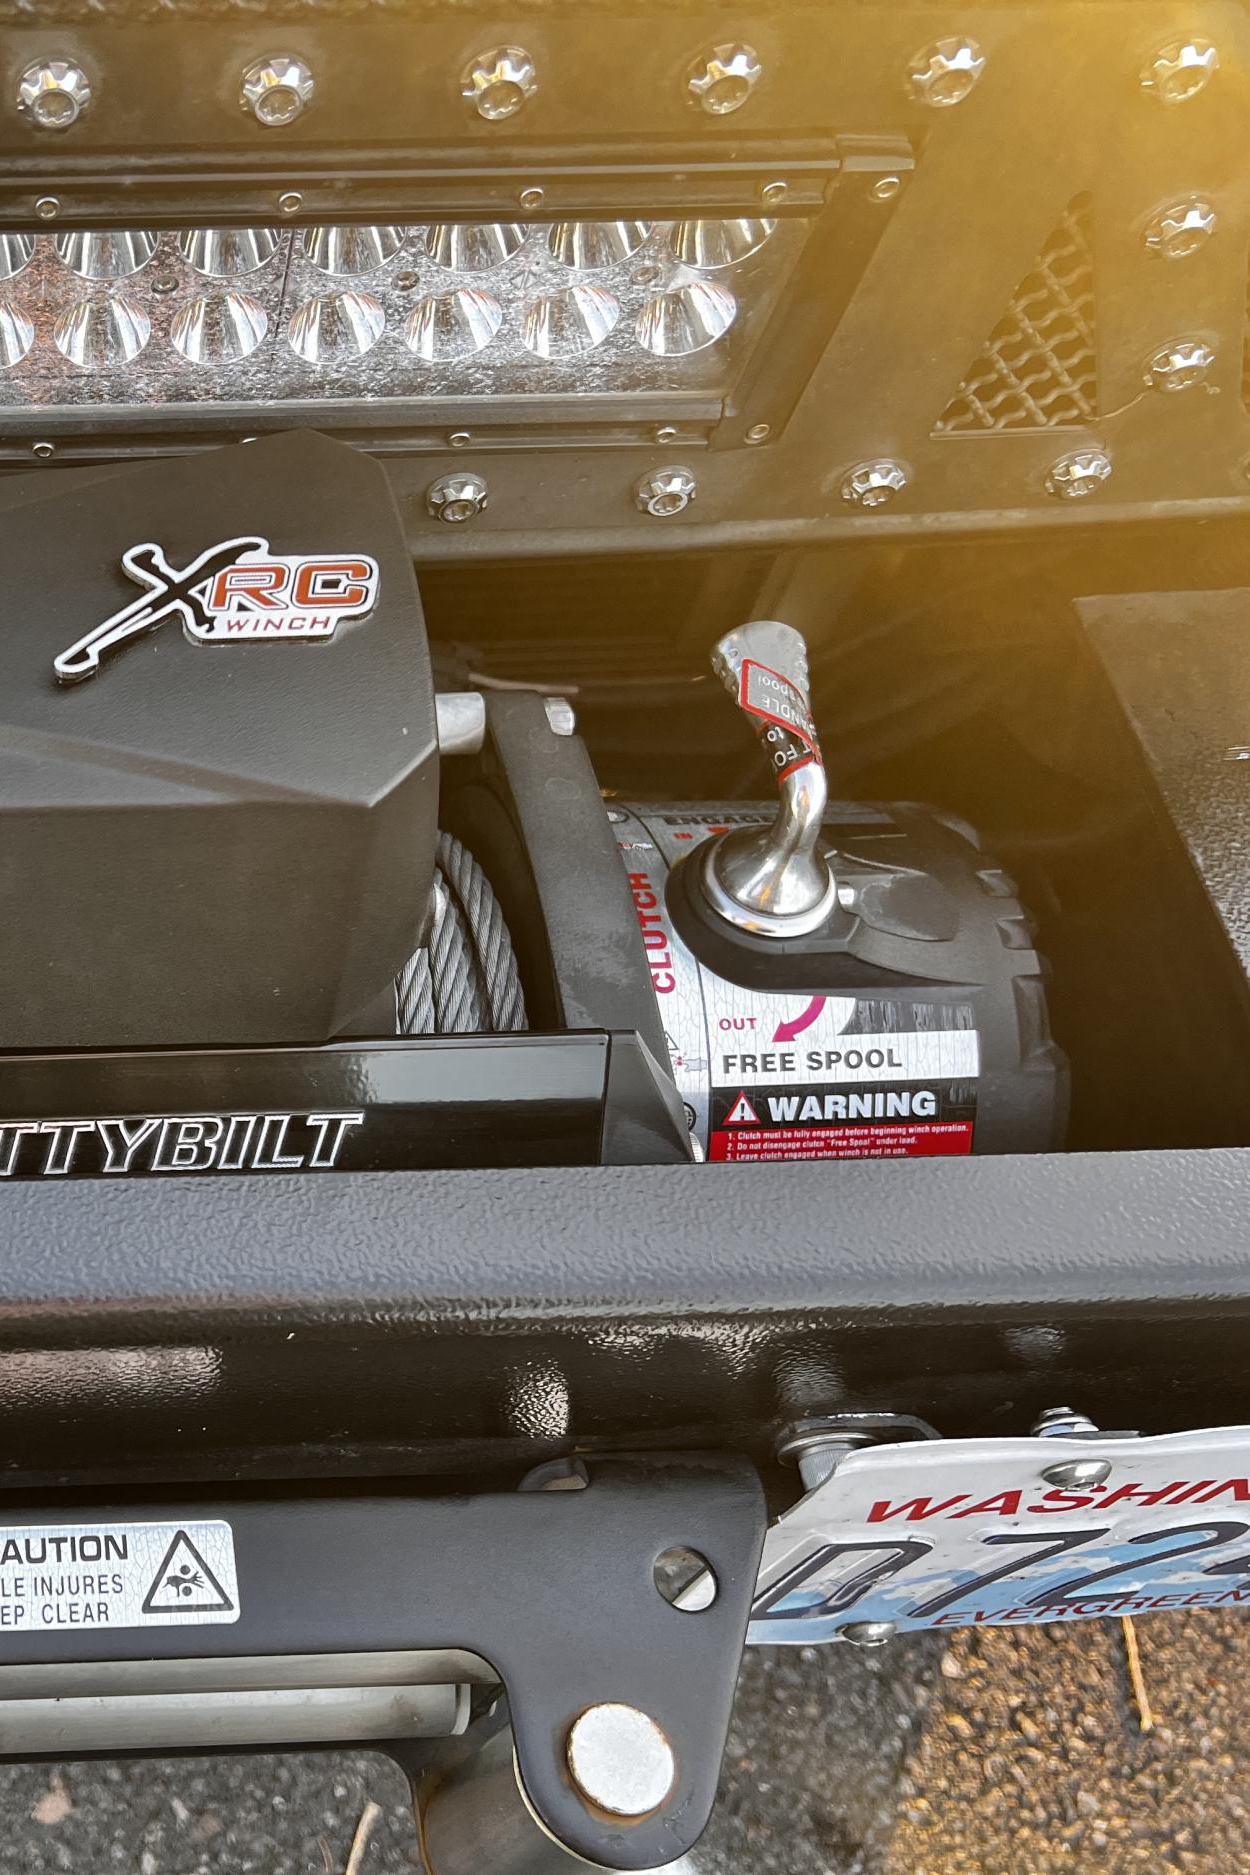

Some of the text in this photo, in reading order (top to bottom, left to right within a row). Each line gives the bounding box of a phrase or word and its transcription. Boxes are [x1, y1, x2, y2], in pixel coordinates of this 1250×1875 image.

[227, 616, 331, 632] WINCH
[628, 872, 676, 994] CLUTCH
[718, 1018, 757, 1031] OUT
[723, 1048, 903, 1074] FREE SPOOL
[767, 1090, 936, 1122] WARNING
[737, 1131, 761, 1139] Clutch
[763, 1130, 781, 1139] must
[783, 1129, 792, 1138] be
[793, 1129, 810, 1139] fully
[812, 1128, 843, 1138] engaged
[845, 1127, 869, 1136] before
[870, 1126, 906, 1136] beginning
[908, 1125, 930, 1133] winch
[931, 1124, 968, 1134] operation.
[737, 1142, 747, 1150] Do
[749, 1142, 761, 1150] not
[876, 1137, 897, 1145] under
[736, 1152, 758, 1161] Leave
[760, 1151, 782, 1160] clutch
[784, 1150, 815, 1160] engaged
[838, 1148, 860, 1156] winch
[34, 1574, 124, 1596] INJURES
[41, 1602, 110, 1625] CLEAR
